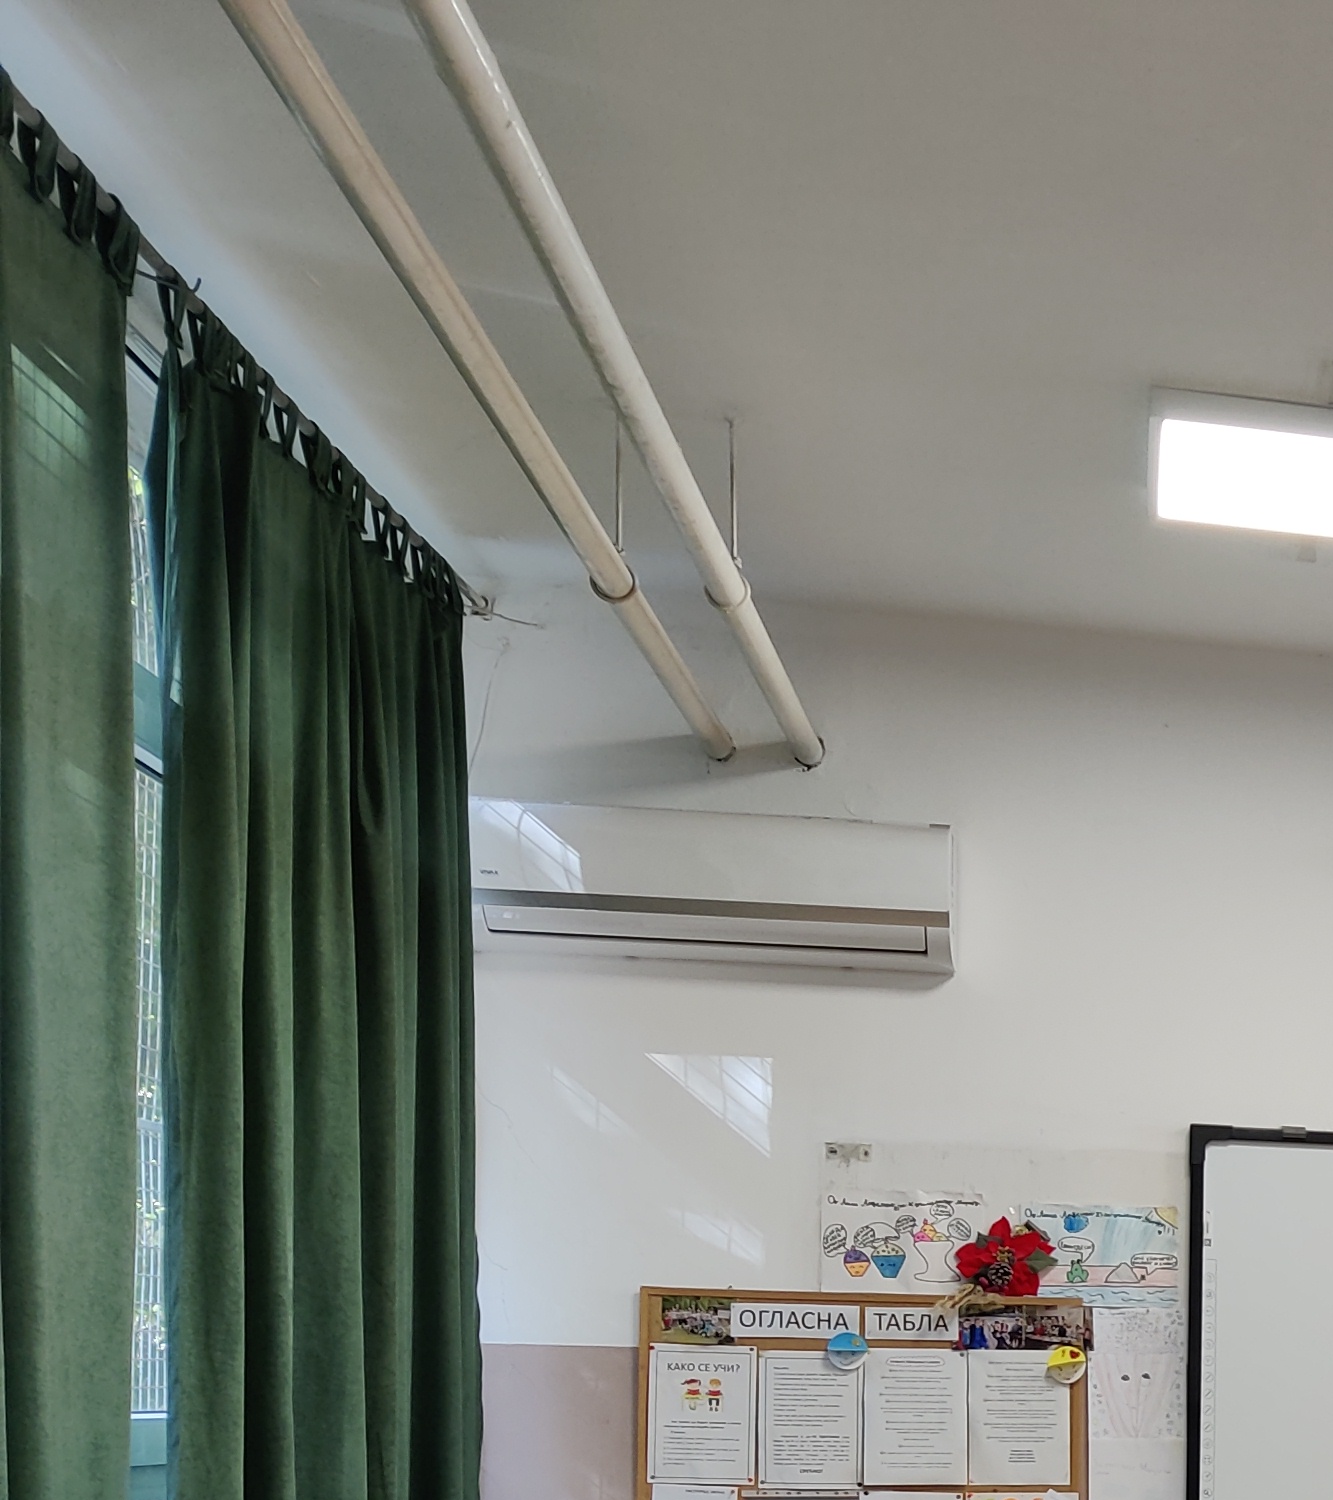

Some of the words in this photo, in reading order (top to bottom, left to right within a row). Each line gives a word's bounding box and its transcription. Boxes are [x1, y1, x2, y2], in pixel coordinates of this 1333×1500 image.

[739, 1309, 849, 1331] ОГЛАСНА
[873, 1312, 949, 1333] ТАБЛА
[667, 1362, 695, 1372] КАКО
[697, 1363, 711, 1372] СЕ
[712, 1363, 741, 1373] УЧИ?
